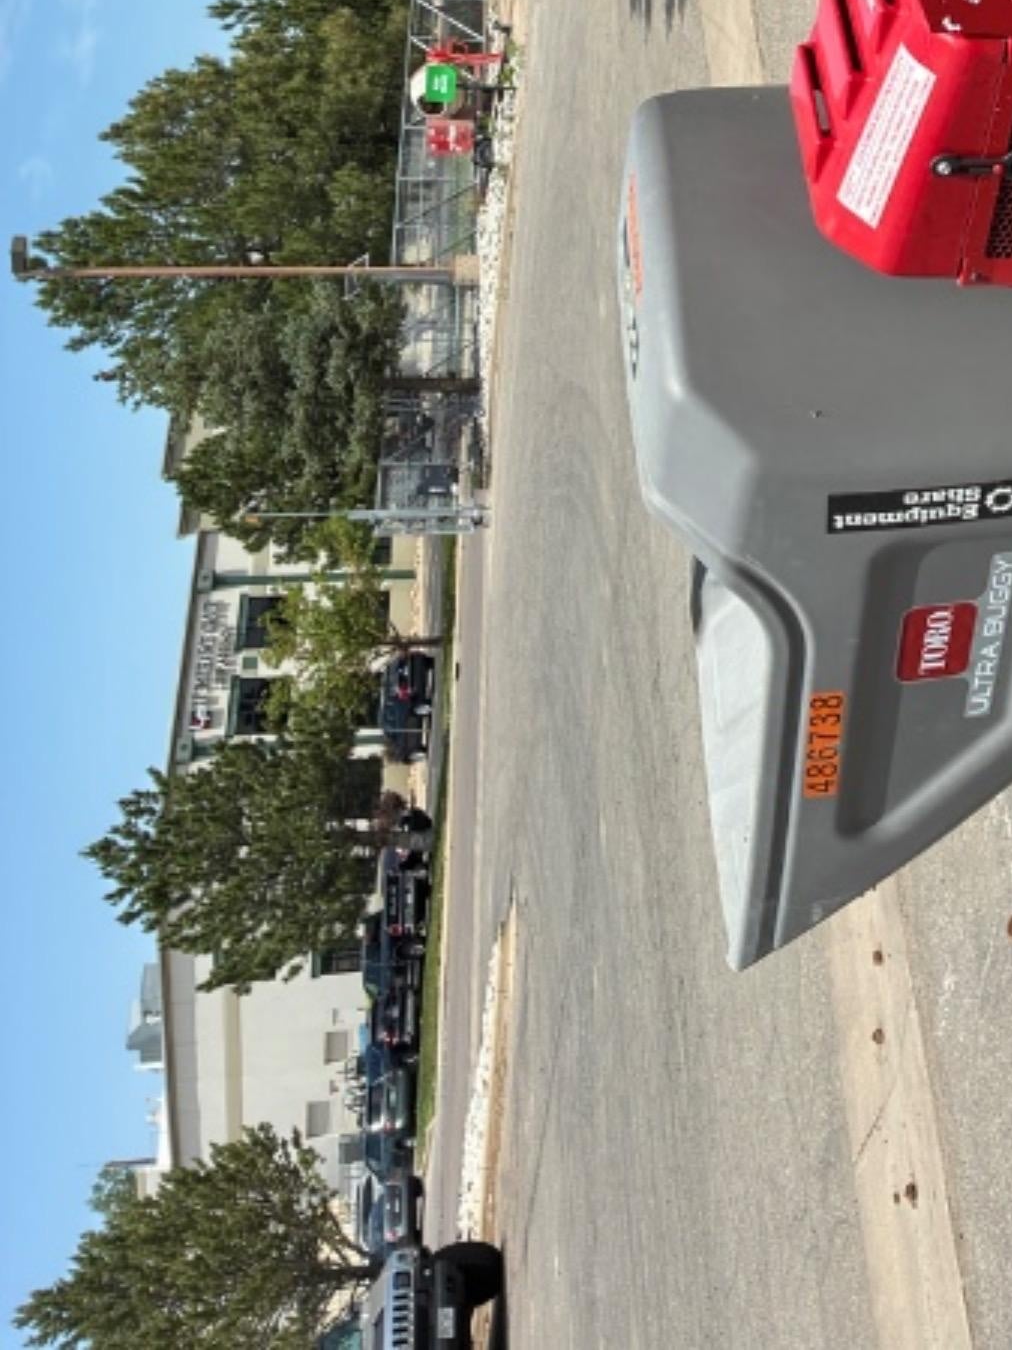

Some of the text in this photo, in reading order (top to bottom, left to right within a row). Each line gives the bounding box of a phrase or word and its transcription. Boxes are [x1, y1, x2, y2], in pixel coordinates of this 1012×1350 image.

[833, 504, 979, 529] Equipment
[903, 487, 981, 505] Share
[918, 610, 954, 675] TORO
[970, 641, 1000, 715] ULTRA
[806, 696, 842, 794] 486738
